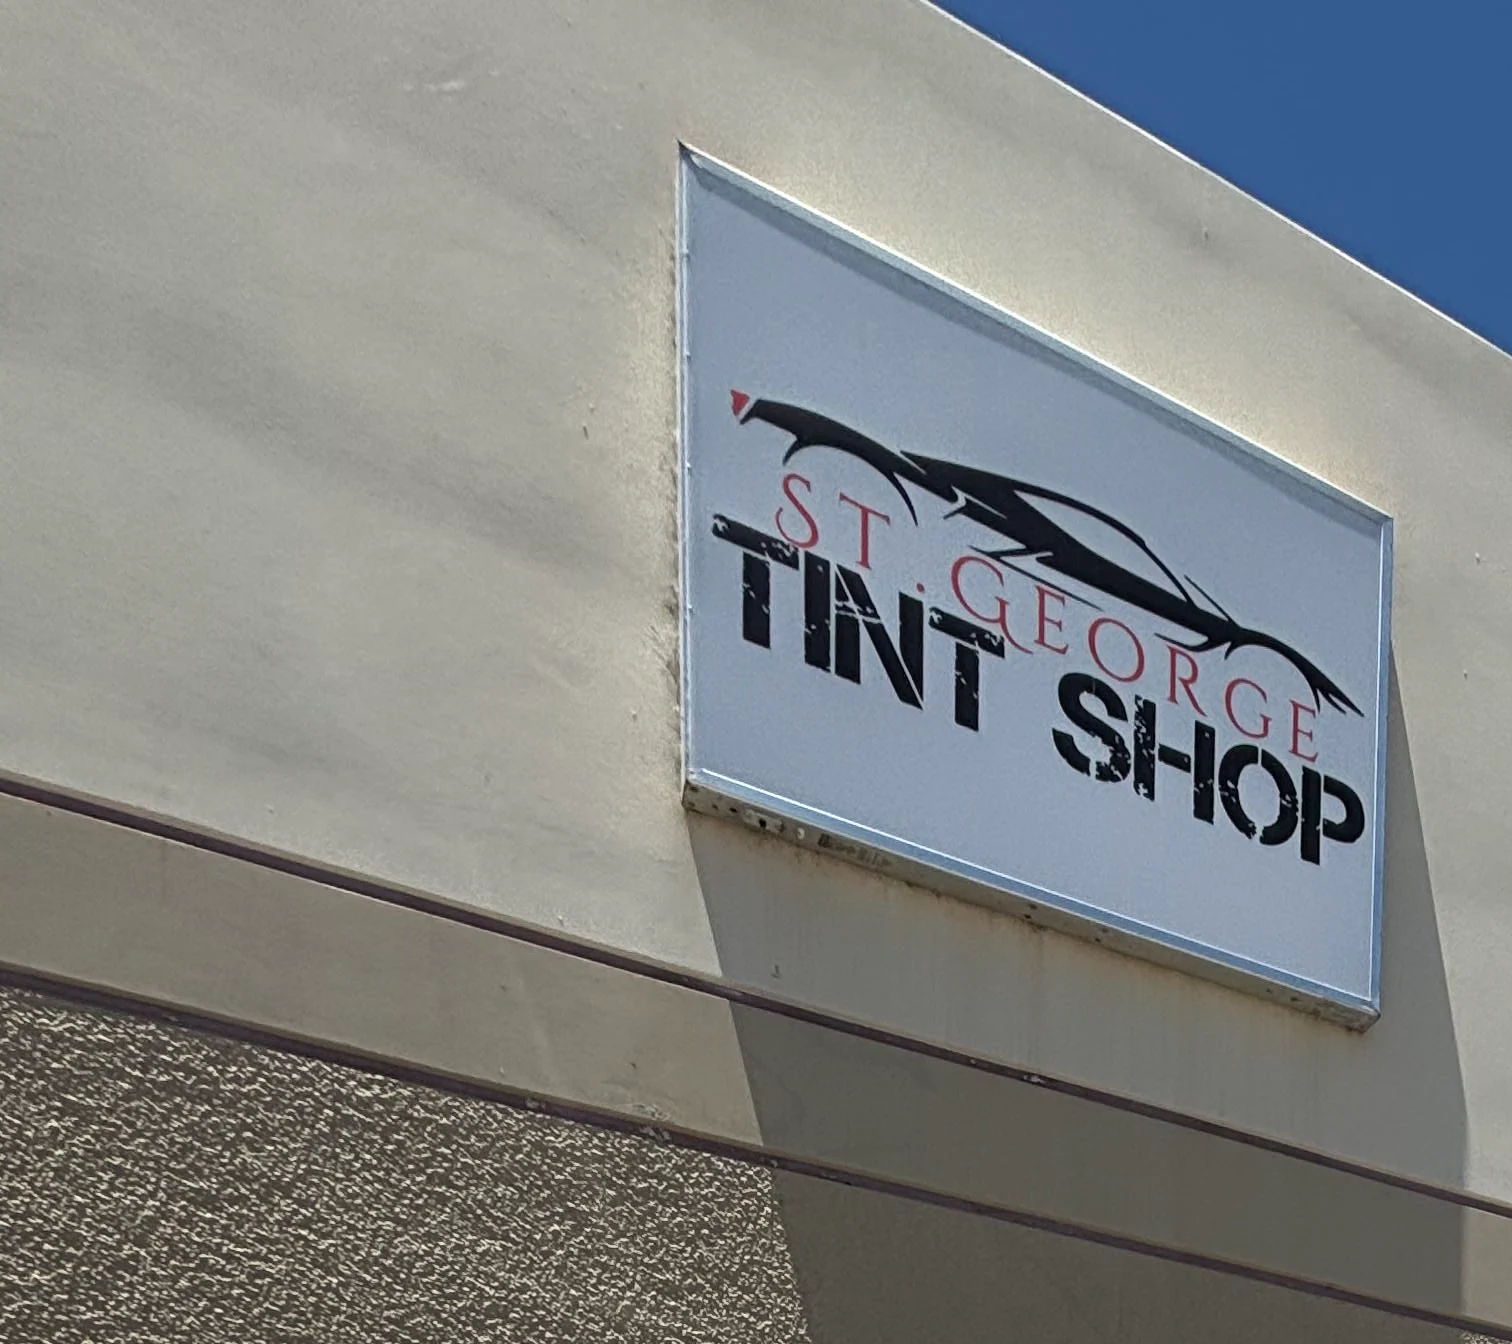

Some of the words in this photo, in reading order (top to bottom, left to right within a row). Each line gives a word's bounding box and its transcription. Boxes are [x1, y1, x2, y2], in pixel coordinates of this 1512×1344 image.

[711, 512, 1006, 733] TINT
[1052, 672, 1367, 867] SHOP
[950, 555, 1320, 763] GEORGE
